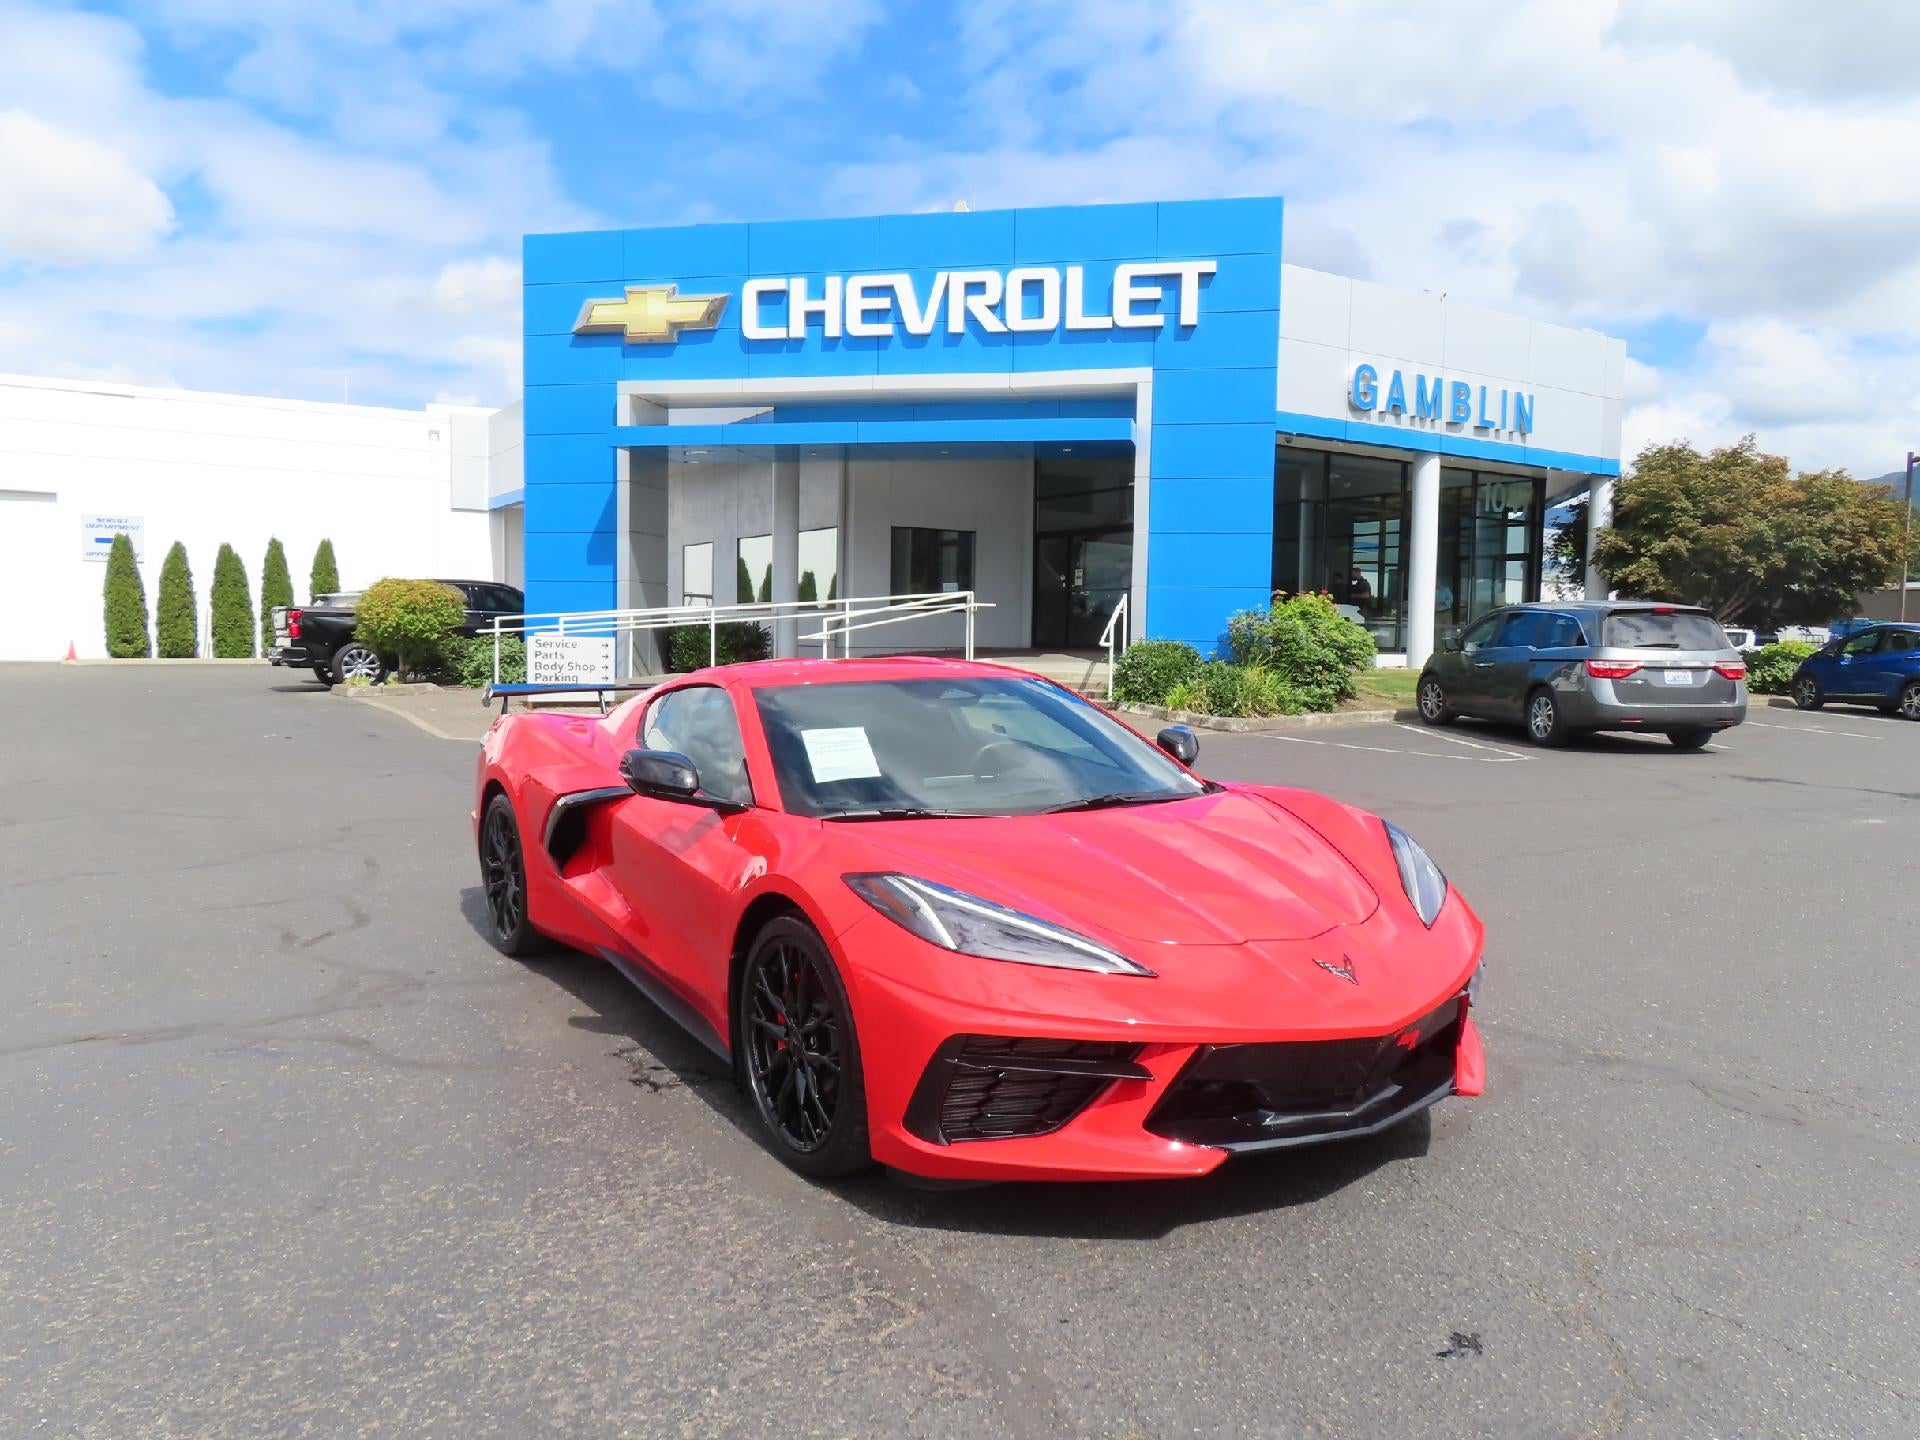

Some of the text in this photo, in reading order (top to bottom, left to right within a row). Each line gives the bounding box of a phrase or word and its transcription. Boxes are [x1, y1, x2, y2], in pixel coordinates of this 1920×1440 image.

[741, 260, 1217, 340] CHEVROLET
[1350, 363, 1534, 434] GAMBLIN
[535, 638, 578, 649] Service
[534, 650, 565, 660] Parts
[534, 661, 596, 673] Body Shop
[534, 672, 578, 684] Parking
